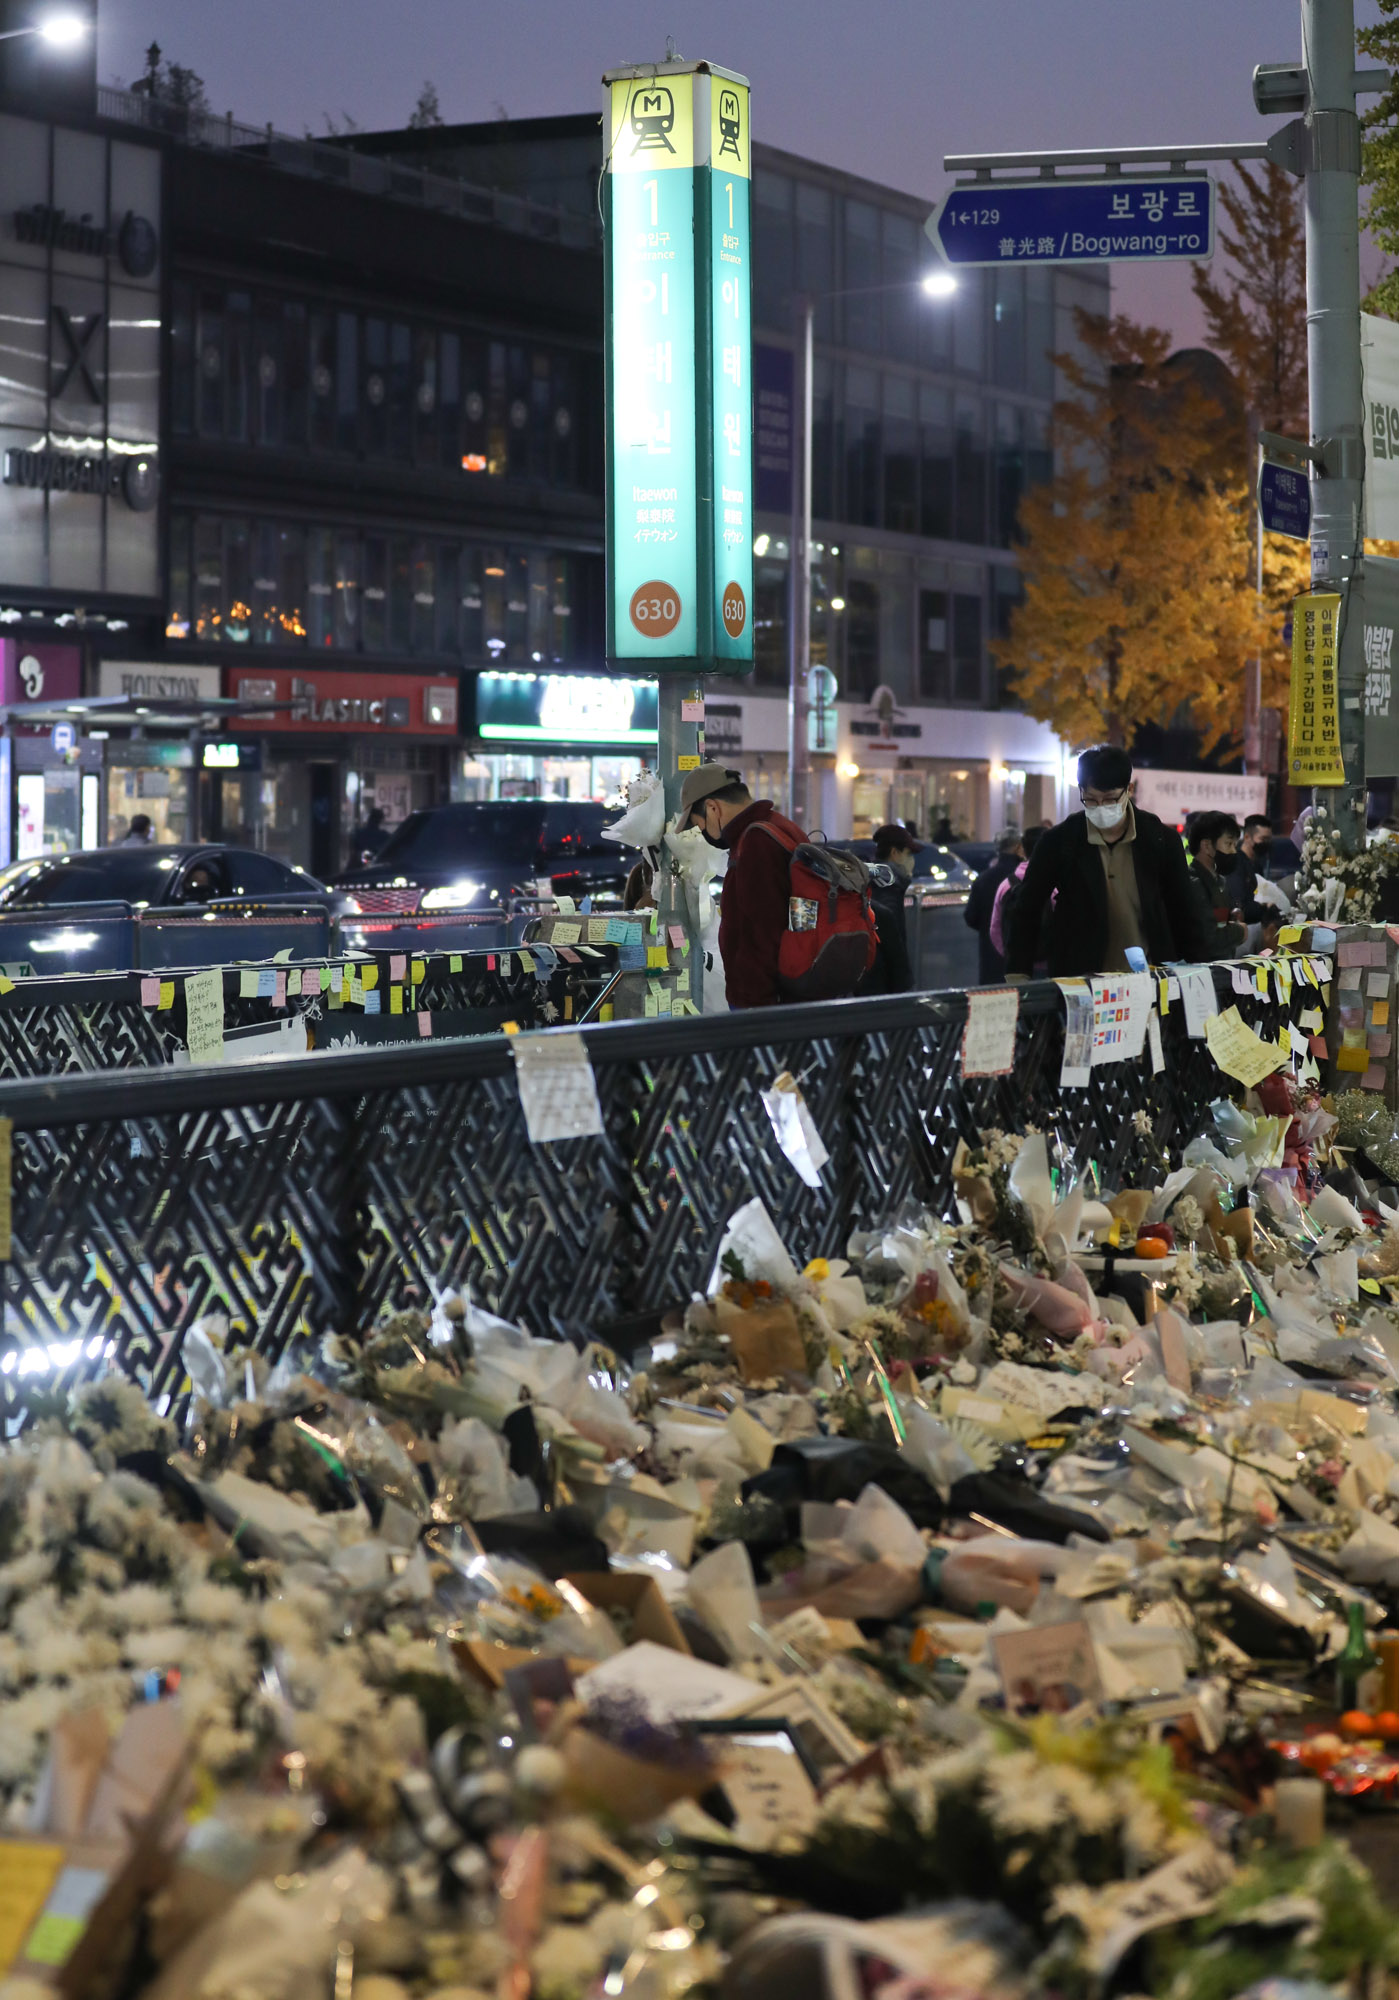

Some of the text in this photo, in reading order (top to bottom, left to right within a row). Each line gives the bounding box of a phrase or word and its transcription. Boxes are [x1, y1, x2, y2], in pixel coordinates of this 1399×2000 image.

[643, 95, 661, 112] M
[643, 179, 658, 226] 1
[725, 182, 734, 229] 1
[1108, 190, 1200, 222] 보광로
[972, 209, 1000, 225] 129
[722, 233, 739, 249] 출입구
[720, 250, 742, 265] Entrance
[721, 276, 741, 457] 이태원
[632, 486, 677, 502] Itaewon
[636, 508, 676, 524] 梨泰院
[633, 528, 678, 544] イテウォン
[635, 598, 676, 621] 630
[724, 599, 744, 622] 630
[1302, 610, 1315, 742] 영상단속 구간입니다
[1321, 715, 1335, 742] 위반
